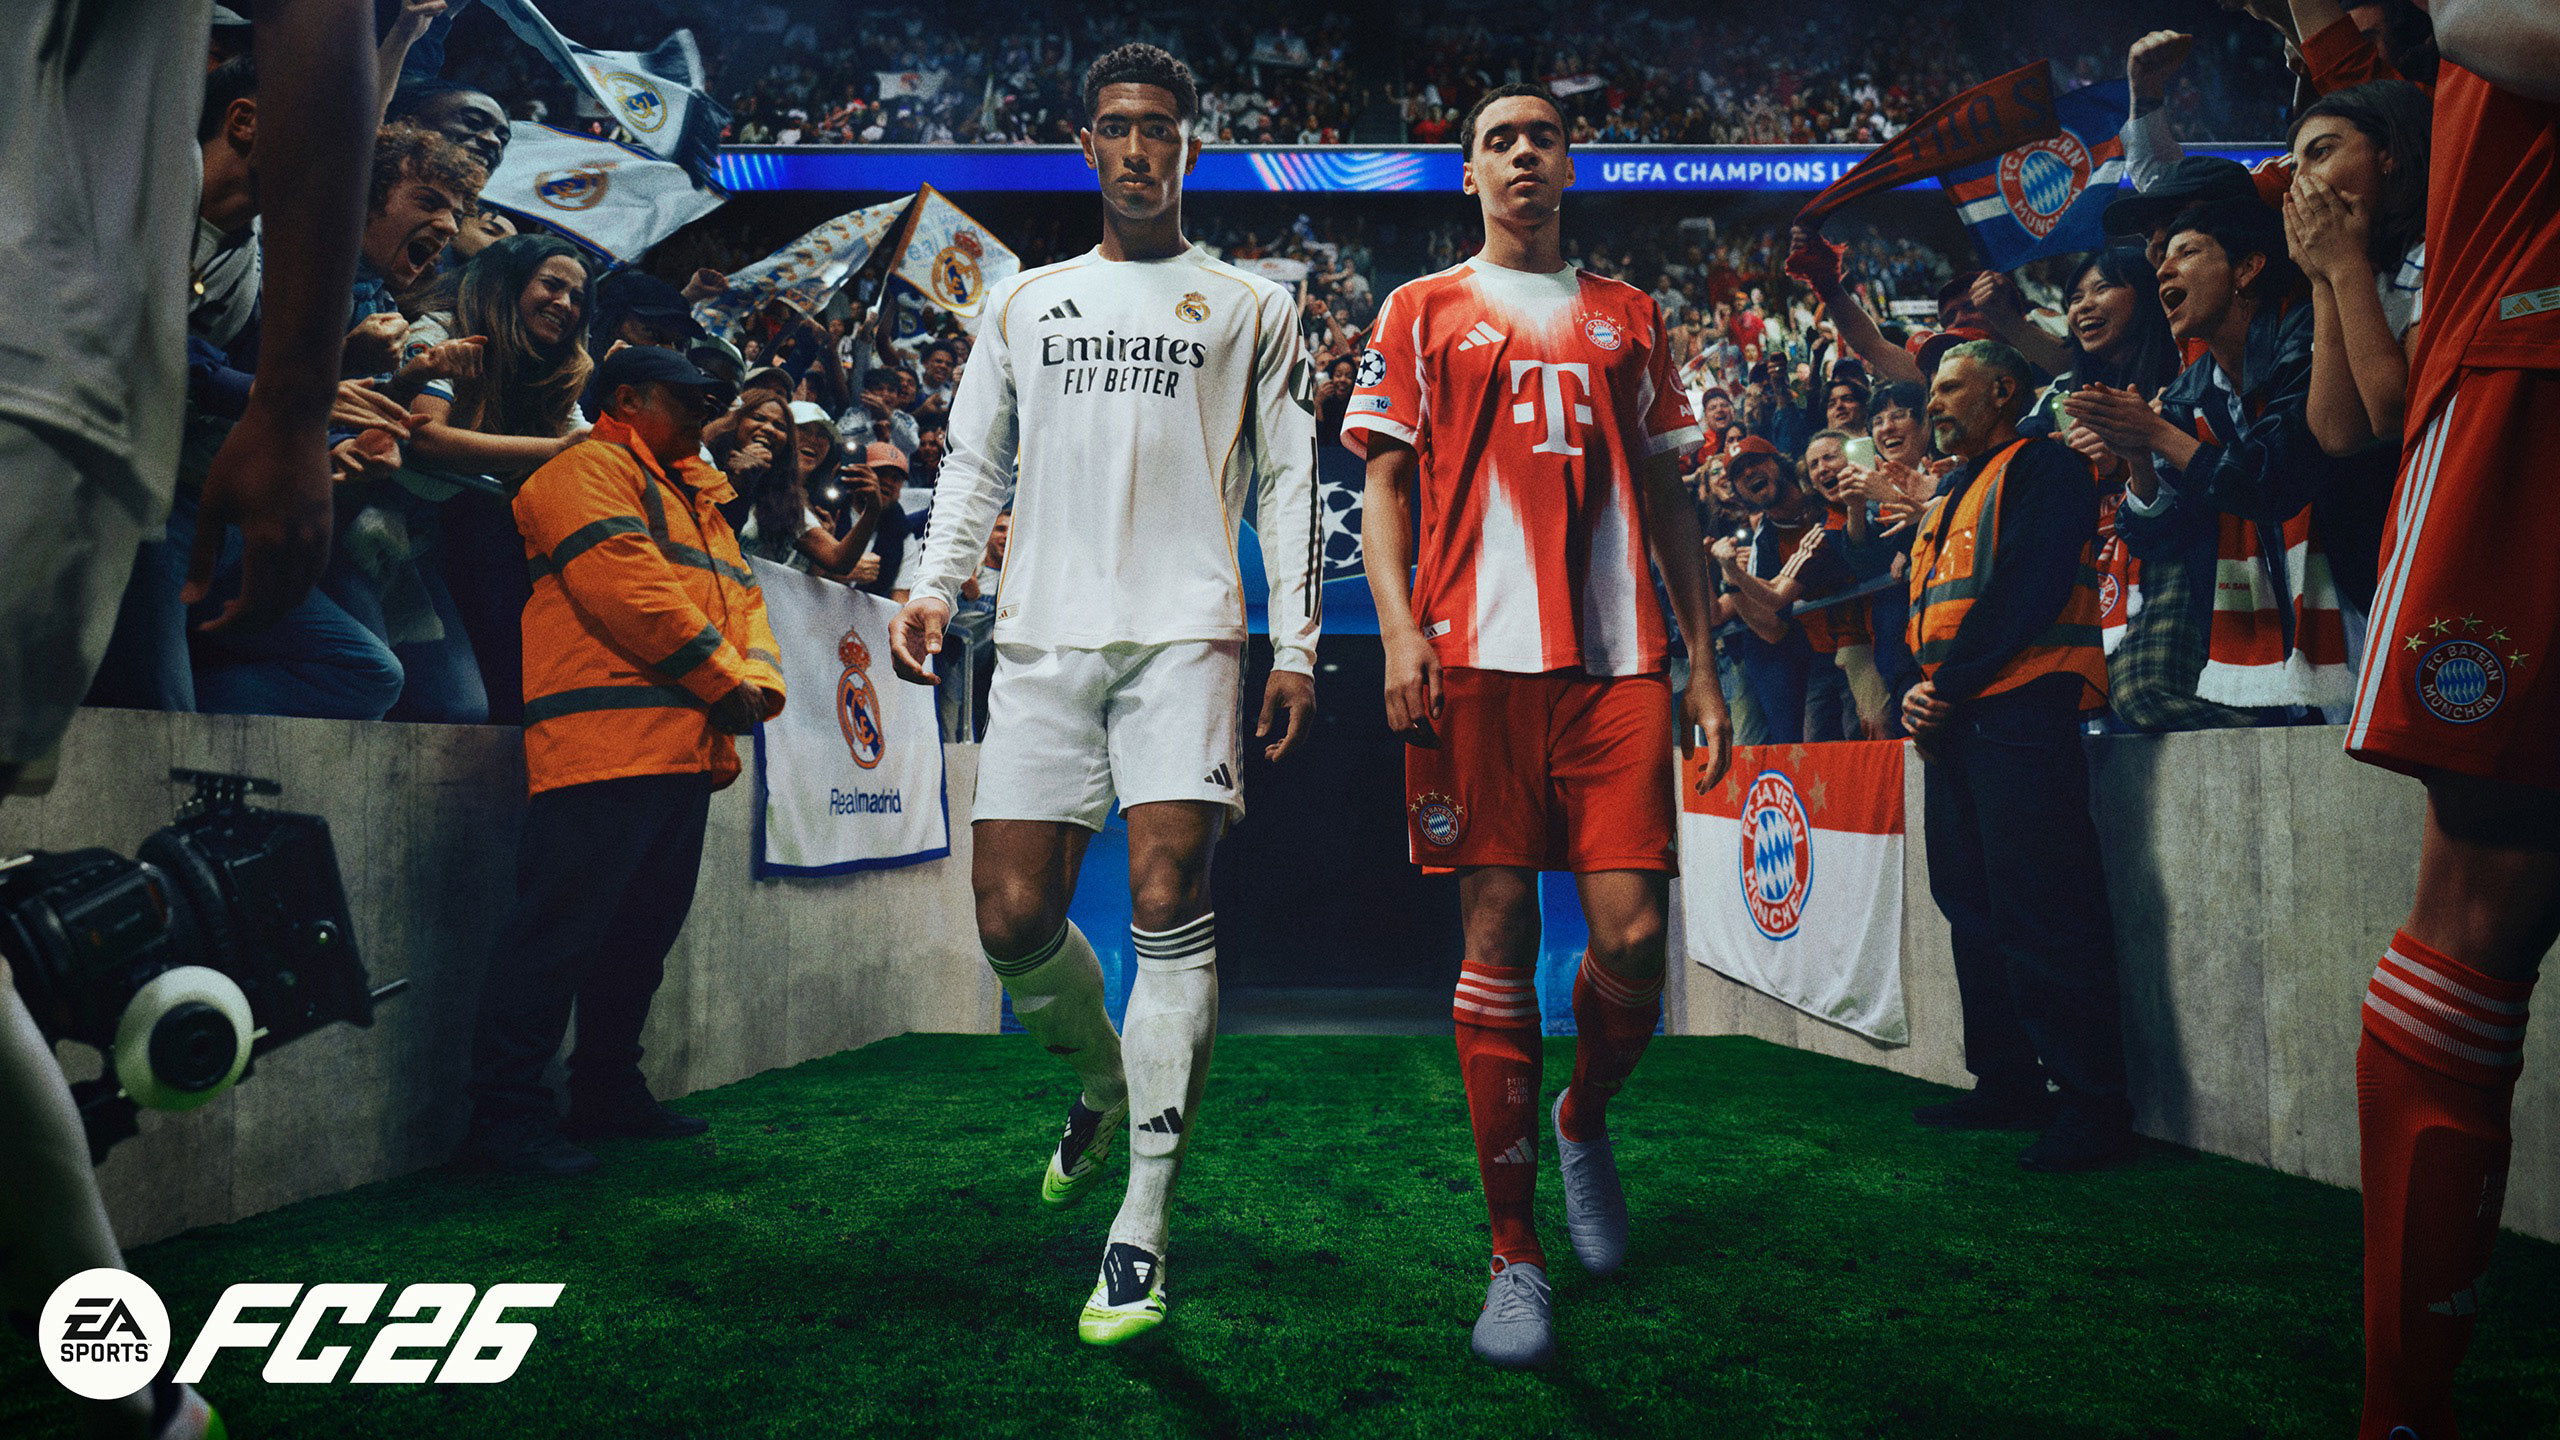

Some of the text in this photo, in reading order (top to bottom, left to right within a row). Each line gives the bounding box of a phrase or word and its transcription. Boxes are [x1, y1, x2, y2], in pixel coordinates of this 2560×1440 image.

[1603, 162, 1667, 183] UEFA
[1673, 162, 1826, 183] CHAMPIONS
[2003, 155, 2020, 181] FC
[1042, 330, 1207, 368] Emirates
[1064, 367, 1180, 399] FLY BETTER
[1510, 359, 1593, 456] T
[2425, 644, 2501, 681] FC BAYERN
[1743, 803, 1760, 841] FC
